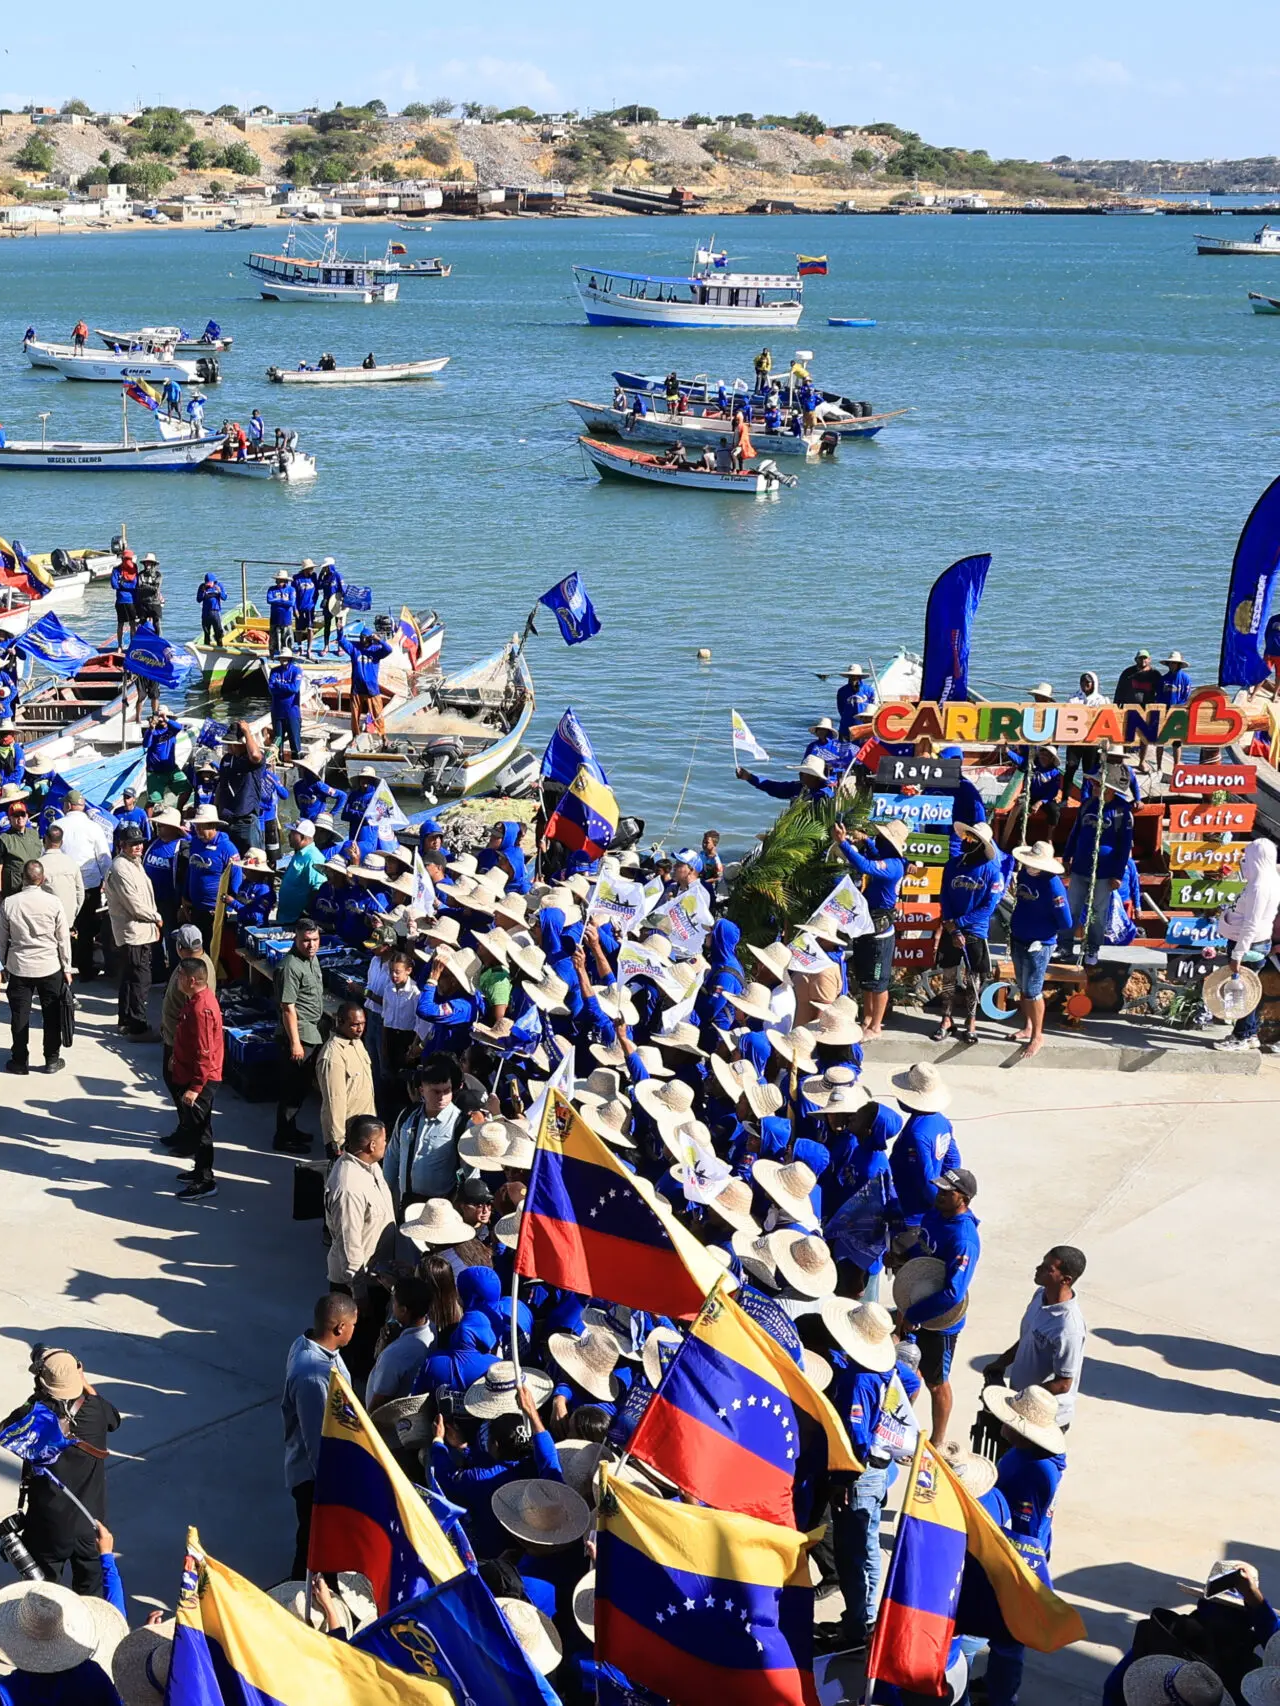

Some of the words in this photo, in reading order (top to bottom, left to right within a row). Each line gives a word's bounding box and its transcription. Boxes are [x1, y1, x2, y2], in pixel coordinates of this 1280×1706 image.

[875, 704, 1188, 744] CARIRUBANA
[894, 761, 943, 780] Raya
[1174, 769, 1246, 788] Camaron
[875, 798, 920, 821] Pargo
[1179, 810, 1245, 828] Carite
[1180, 885, 1236, 904] Bagre
